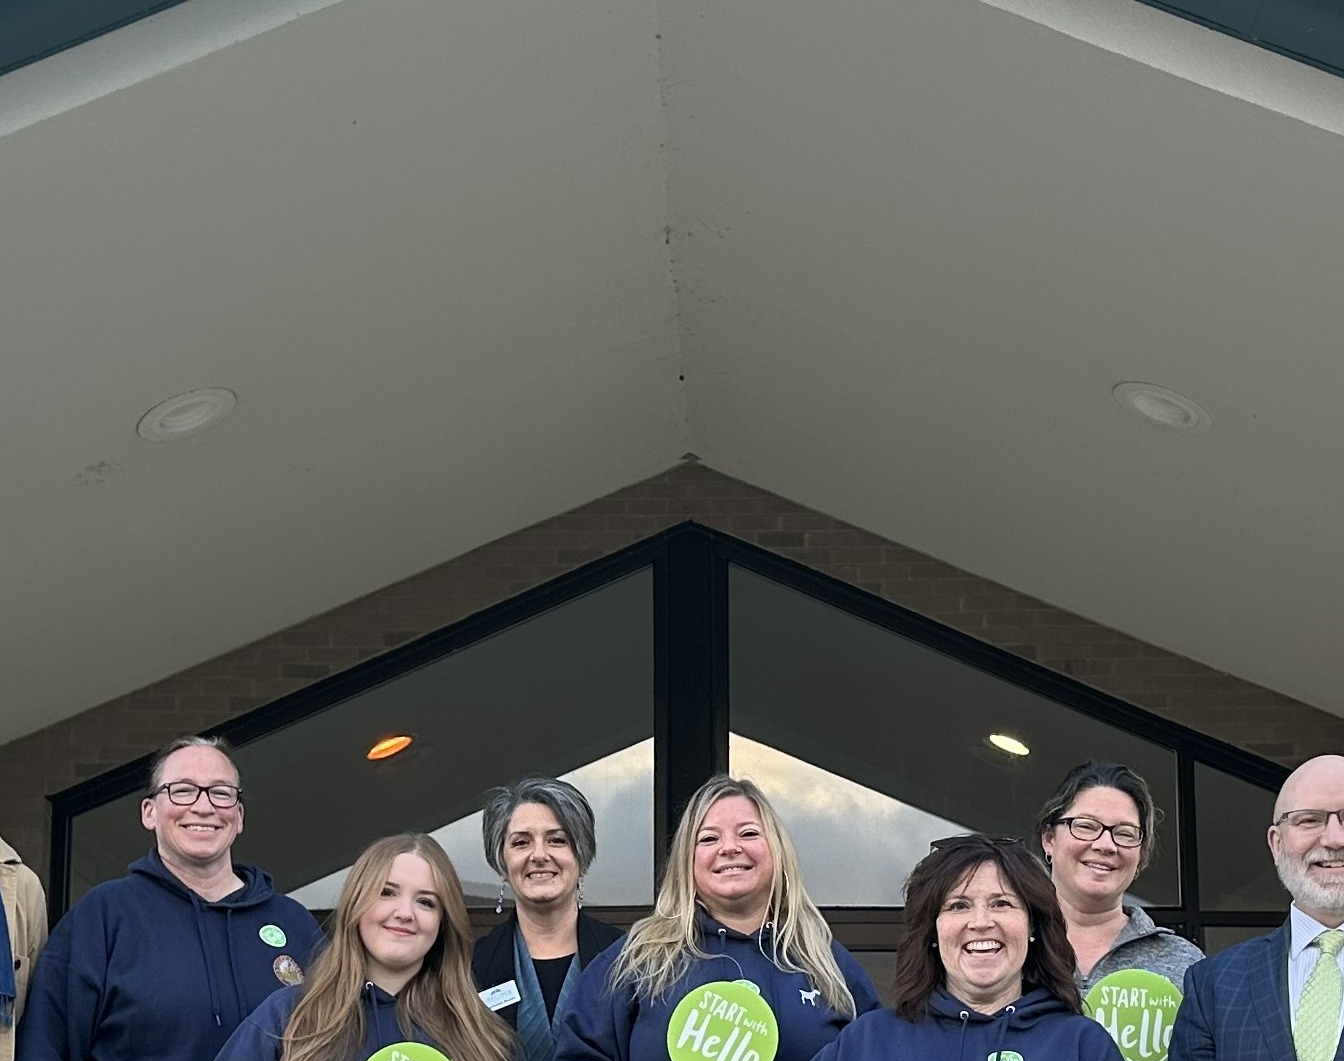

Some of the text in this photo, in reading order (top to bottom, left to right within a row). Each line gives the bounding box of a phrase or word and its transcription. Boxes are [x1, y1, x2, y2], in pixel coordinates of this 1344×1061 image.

[699, 991, 768, 1036] START with
[1099, 986, 1175, 1008] START with
